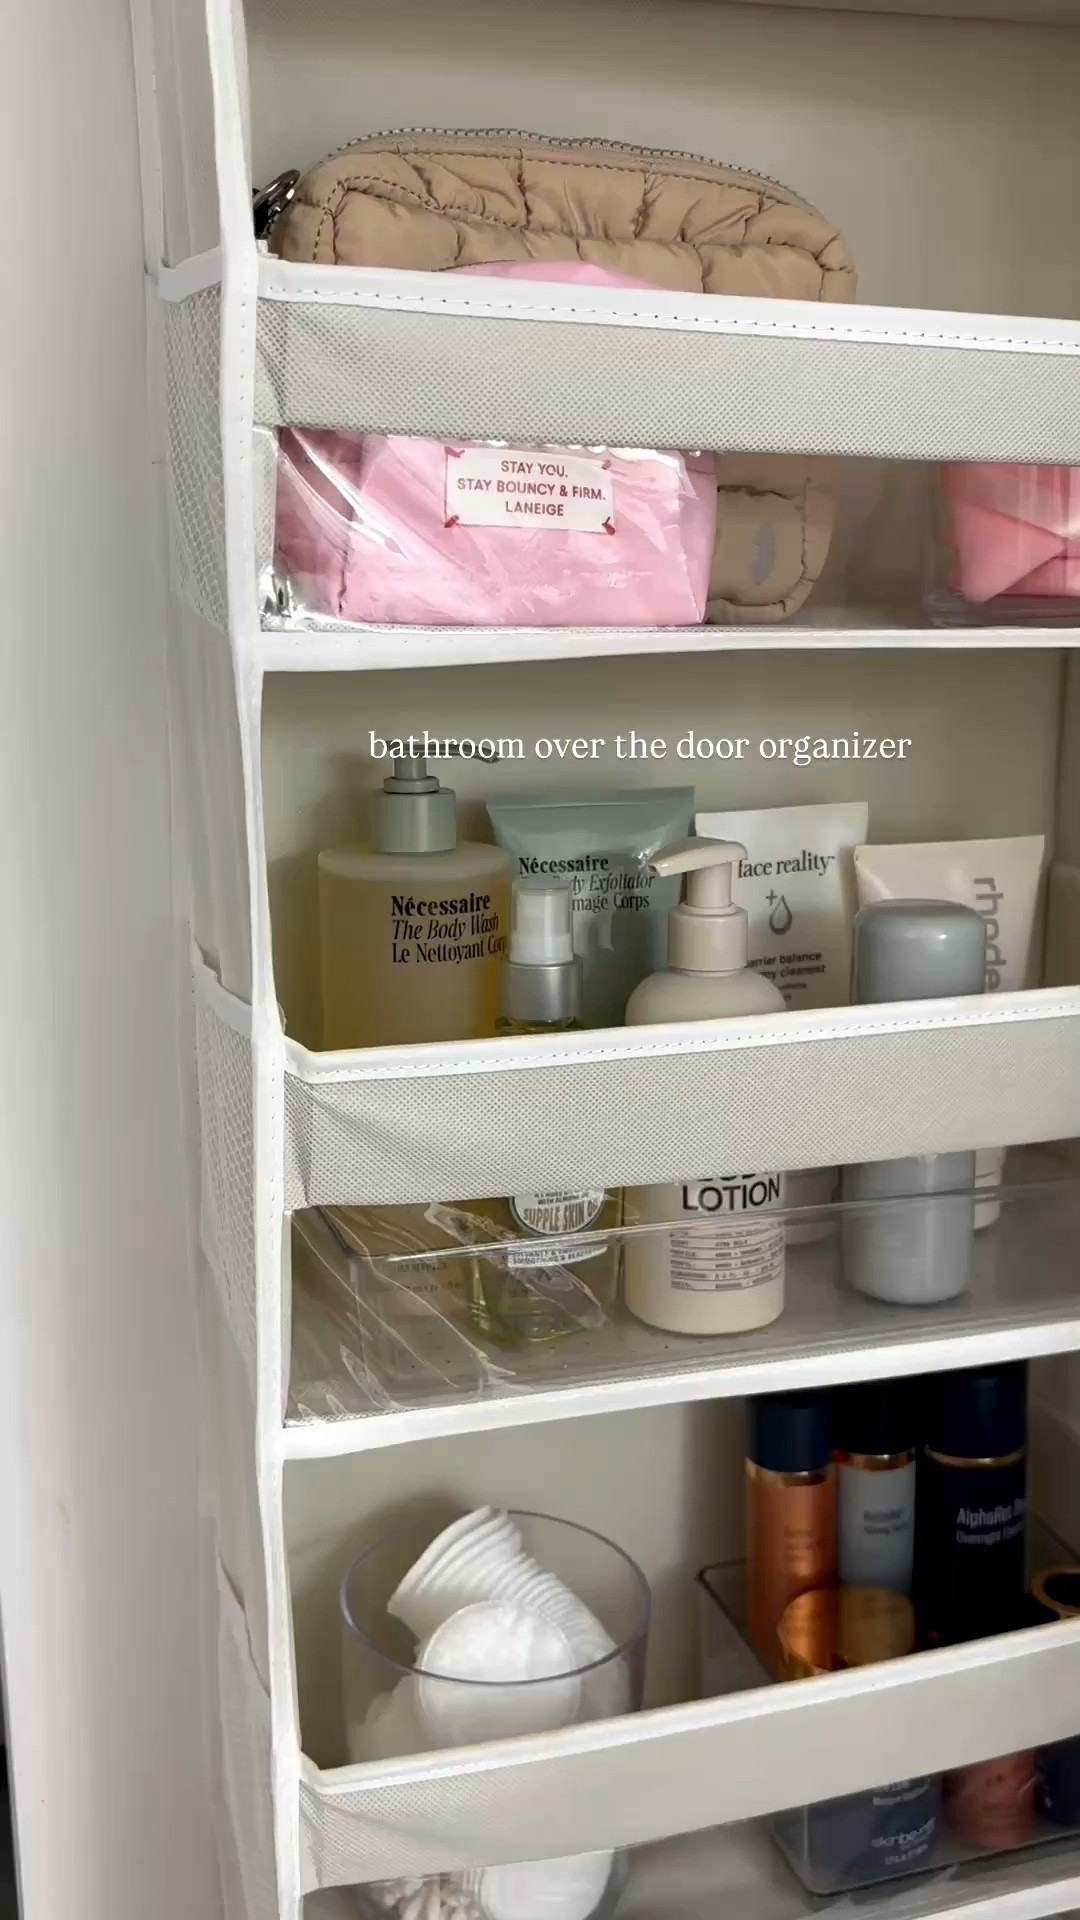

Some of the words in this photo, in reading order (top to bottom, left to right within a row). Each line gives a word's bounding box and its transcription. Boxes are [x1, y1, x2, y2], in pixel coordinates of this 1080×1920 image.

[501, 460, 533, 474] STAY
[538, 463, 569, 478] YOU.
[457, 478, 492, 491] STAY
[497, 480, 556, 496] BOUNCY
[560, 486, 568, 497] &
[572, 486, 606, 500] FIRM.
[505, 501, 564, 516] LANEIGE
[519, 855, 609, 875] Nécessaire
[589, 871, 655, 894] Exfoliator
[391, 892, 491, 917] Nécessaire
[613, 893, 650, 912] Corps
[392, 919, 424, 940] The
[427, 918, 467, 942] Body
[470, 912, 499, 936] Wash
[973, 877, 1007, 990] rhode
[391, 942, 411, 963] Le
[416, 940, 484, 964] Nettoyant
[744, 955, 777, 969] arrier
[682, 1172, 780, 1212] LOTION
[523, 1204, 561, 1232] SUPPLE
[563, 1200, 585, 1232] SKIN
